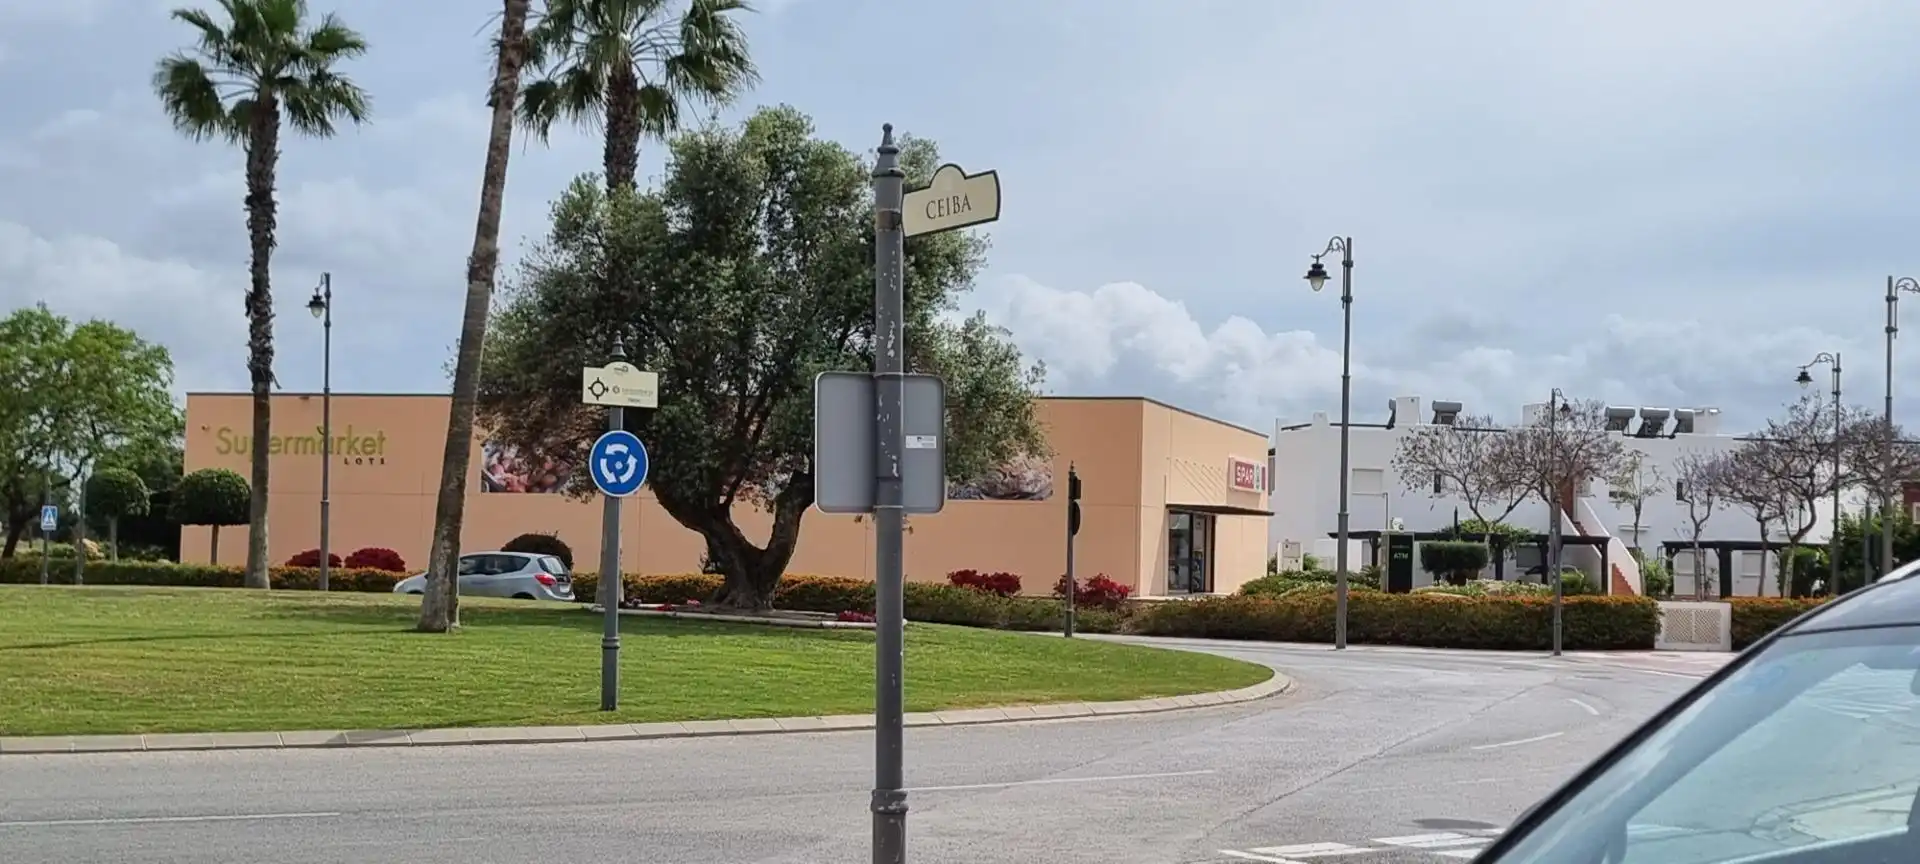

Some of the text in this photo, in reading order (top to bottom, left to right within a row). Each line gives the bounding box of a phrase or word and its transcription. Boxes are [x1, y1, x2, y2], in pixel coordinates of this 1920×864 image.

[926, 193, 972, 220] CEIBA
[215, 425, 386, 463] Suermarket
[1236, 465, 1255, 484] SPAR
